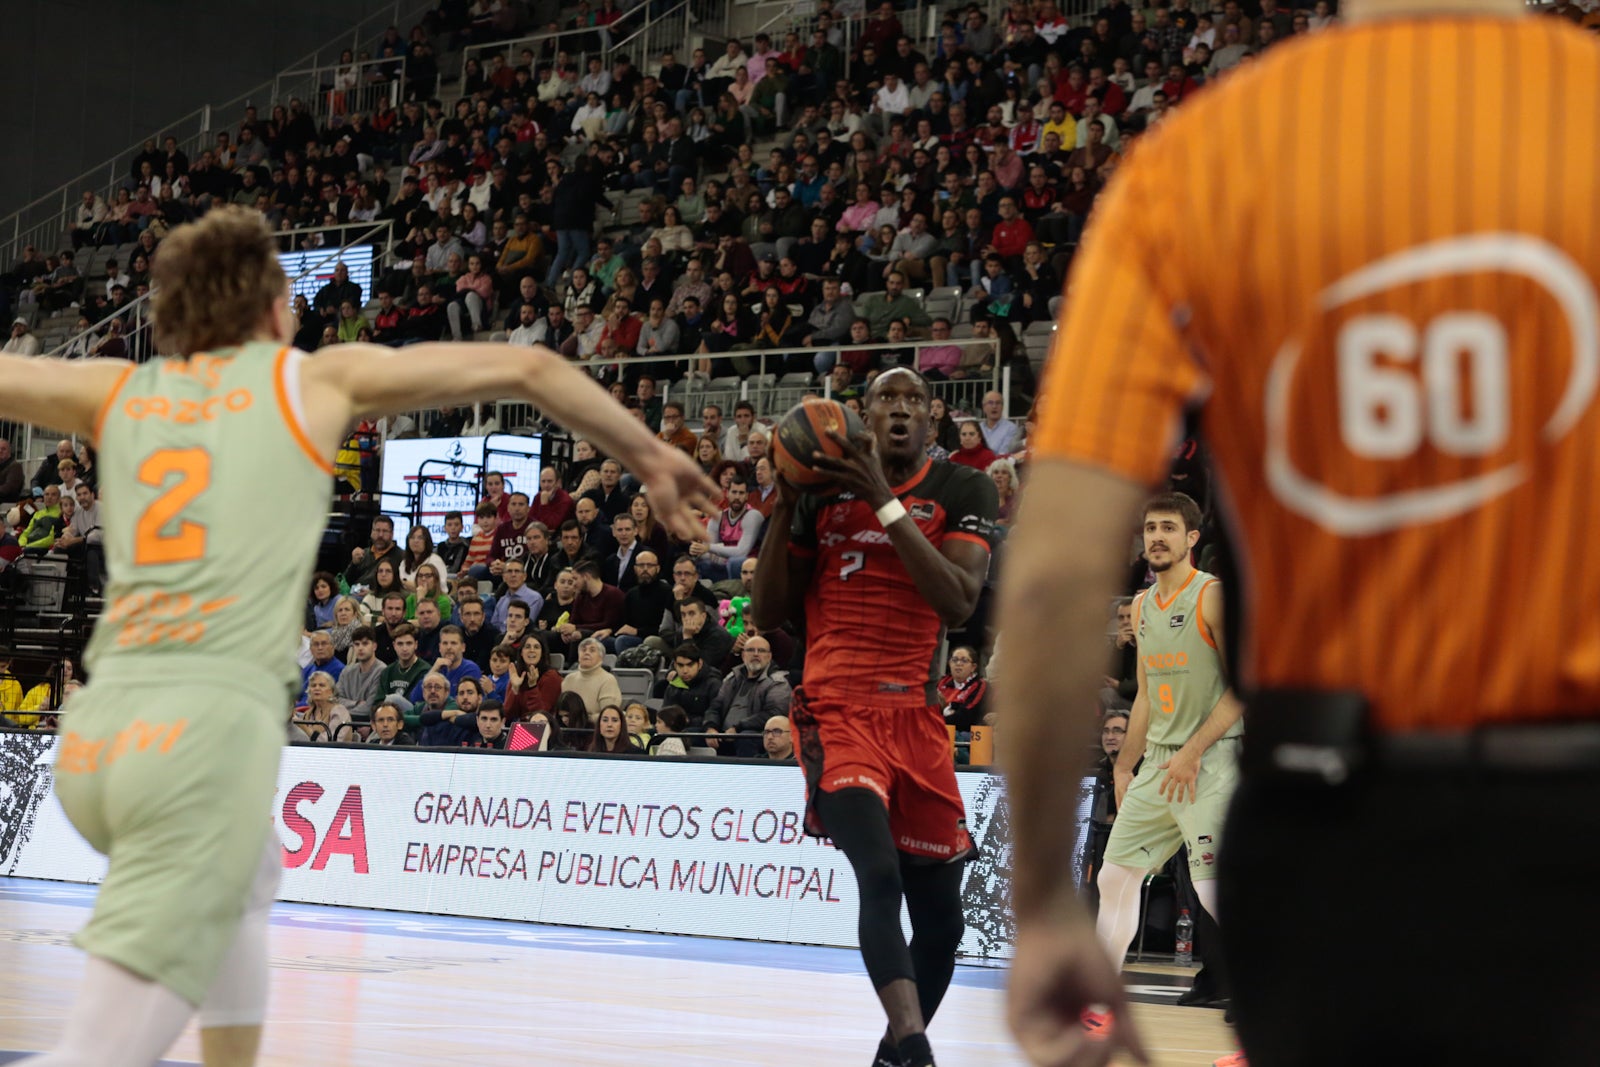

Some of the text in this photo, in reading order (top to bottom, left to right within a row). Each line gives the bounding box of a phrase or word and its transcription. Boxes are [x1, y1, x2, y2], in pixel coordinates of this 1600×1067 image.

[1337, 311, 1510, 460] 60
[134, 447, 212, 565] 2
[1158, 684, 1175, 714] 9
[281, 781, 369, 874] SA
[414, 791, 838, 847] GRANADA EVENTOS GLOB
[403, 841, 840, 902] EMPRESA PÚBLICA MUNICIPAL
